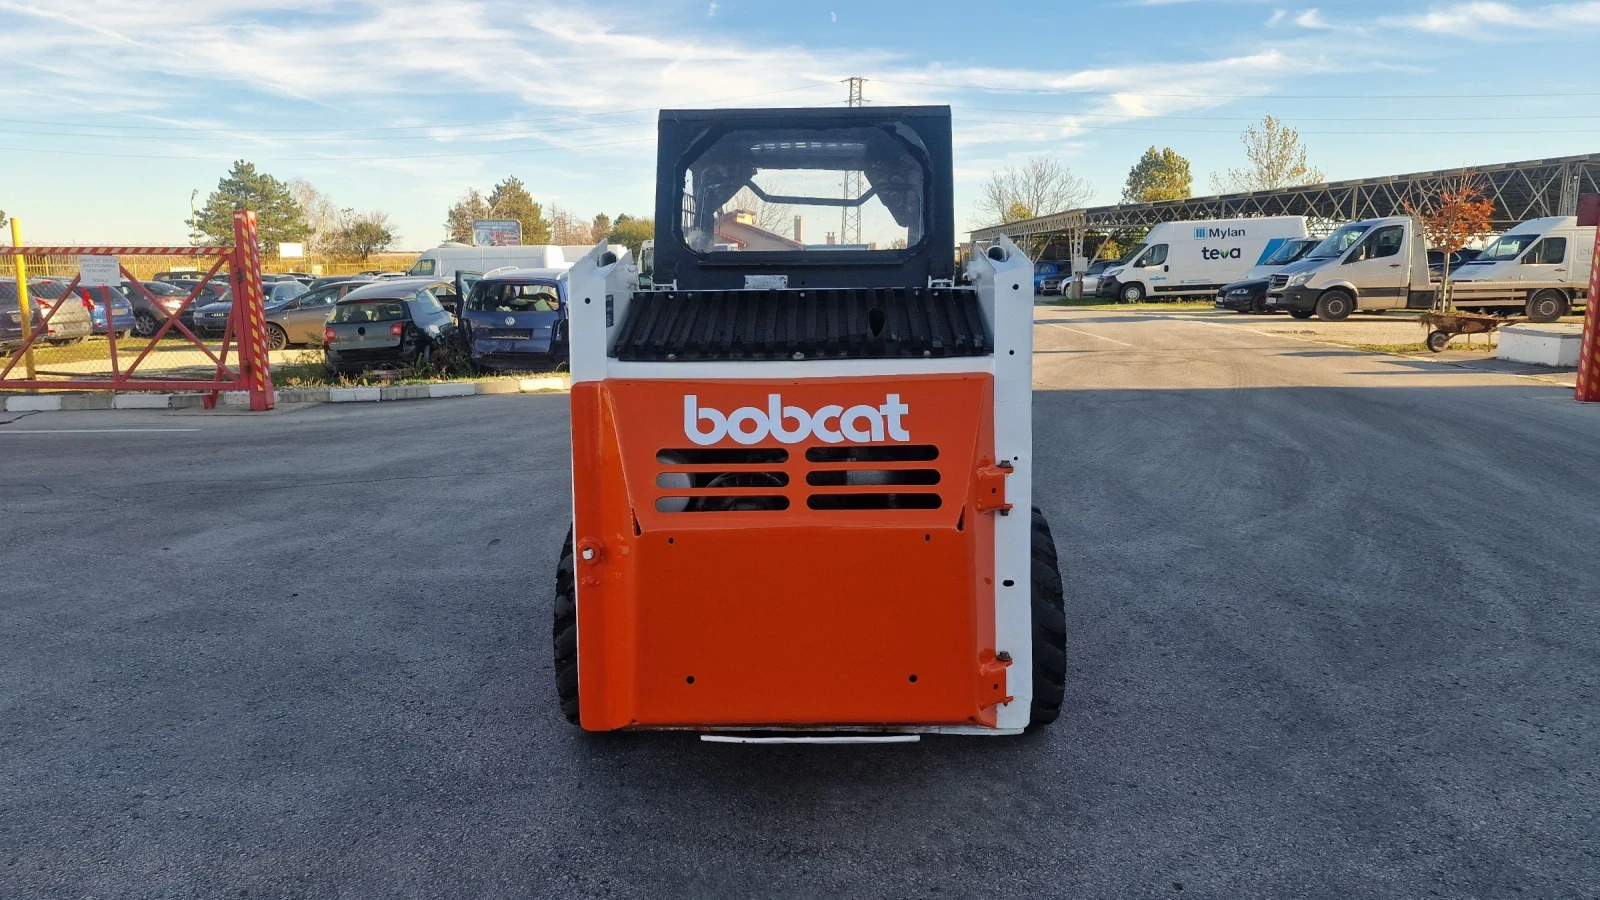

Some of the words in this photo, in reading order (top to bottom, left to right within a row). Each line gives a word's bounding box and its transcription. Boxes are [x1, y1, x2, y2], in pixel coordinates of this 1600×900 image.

[1209, 227, 1246, 239] Mylan
[1201, 246, 1241, 260] teva
[683, 393, 910, 446] bobcat
